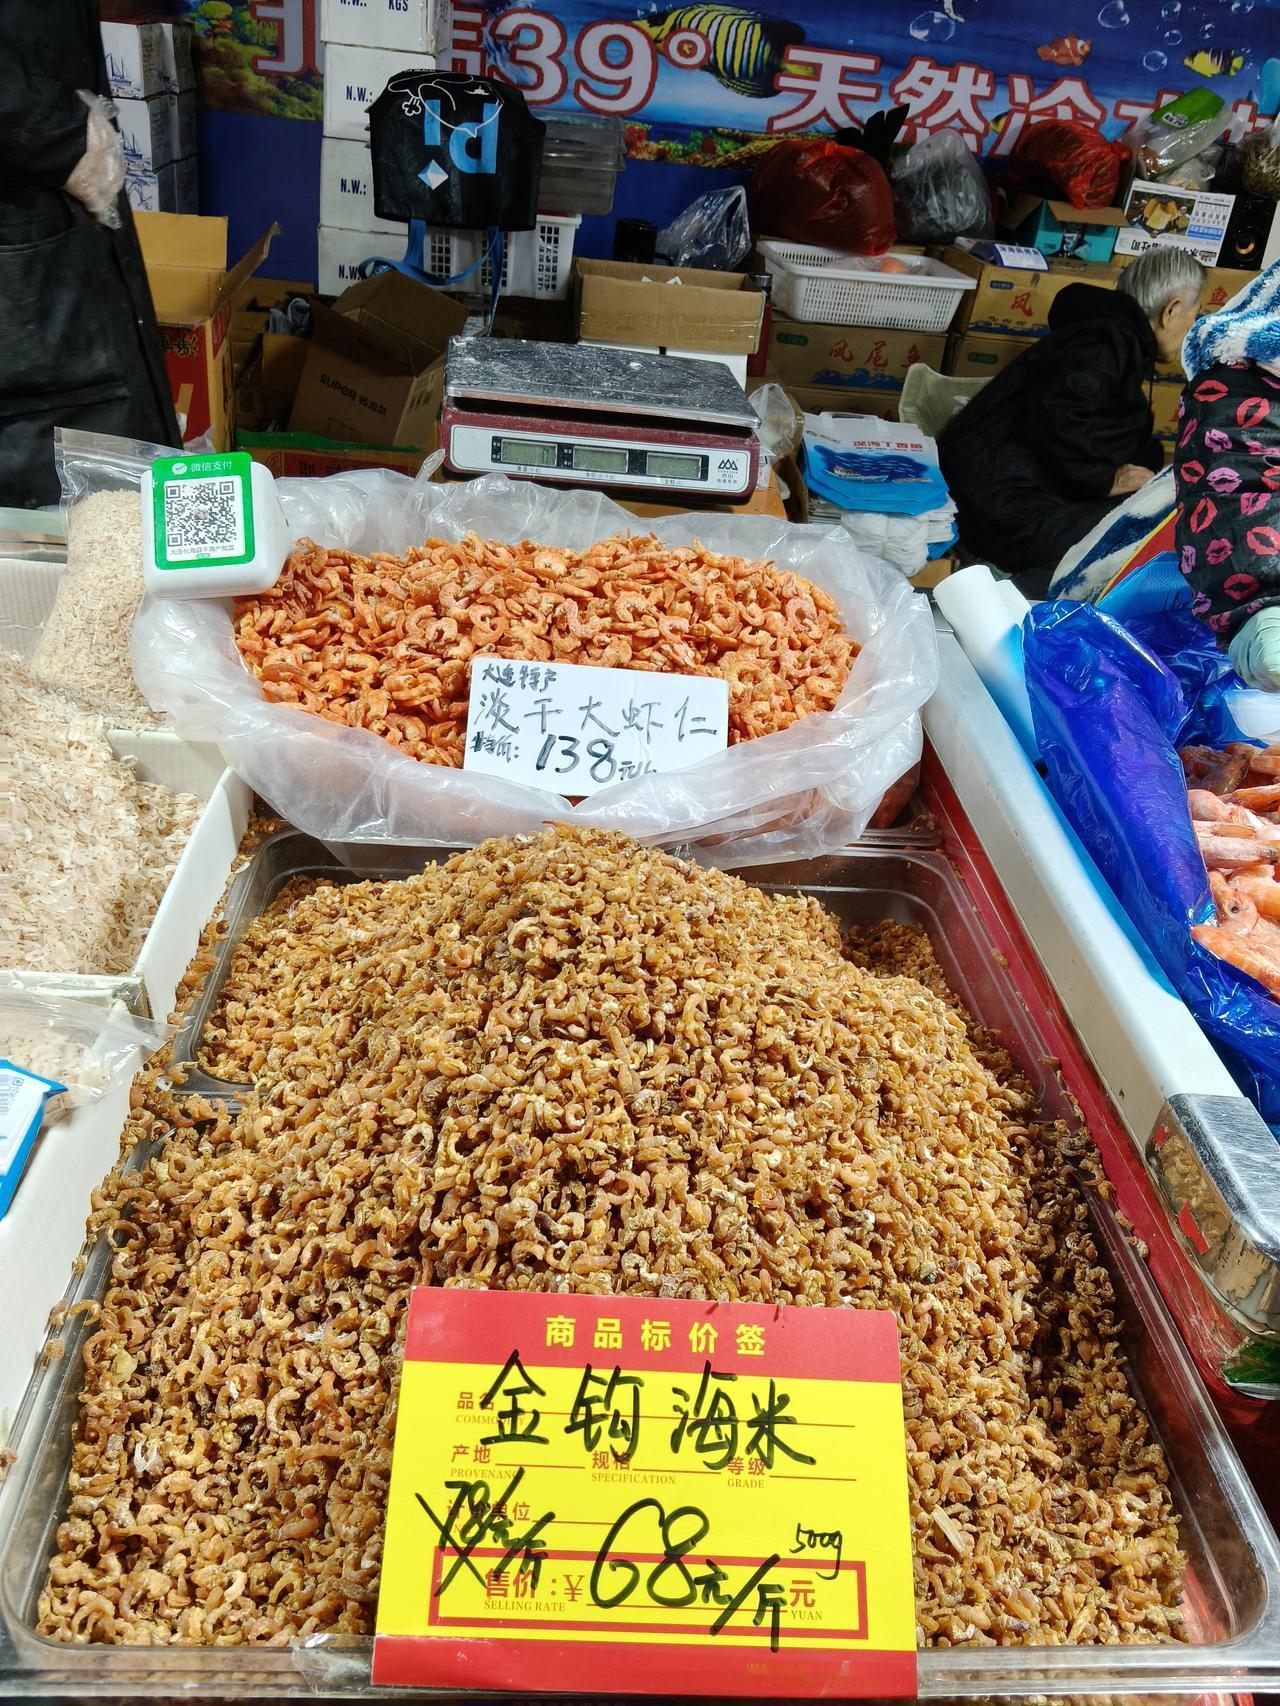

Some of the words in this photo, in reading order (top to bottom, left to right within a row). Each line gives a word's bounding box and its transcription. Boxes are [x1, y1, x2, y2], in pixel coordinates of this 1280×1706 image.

[340, 178, 367, 195] N.W.:
[190, 460, 232, 473] 微信支付
[474, 688, 718, 744] 淡干大虾仁
[545, 1315, 767, 1356] 商品标价签
[479, 1349, 817, 1470] 金钩海米
[451, 1444, 491, 1464] 产地
[591, 1472, 676, 1486] SPECIFICATION
[727, 1478, 765, 1489] GRADE
[484, 1600, 532, 1611] SELLING
[535, 1601, 566, 1612] RATE
[791, 1610, 823, 1621] YUAN
